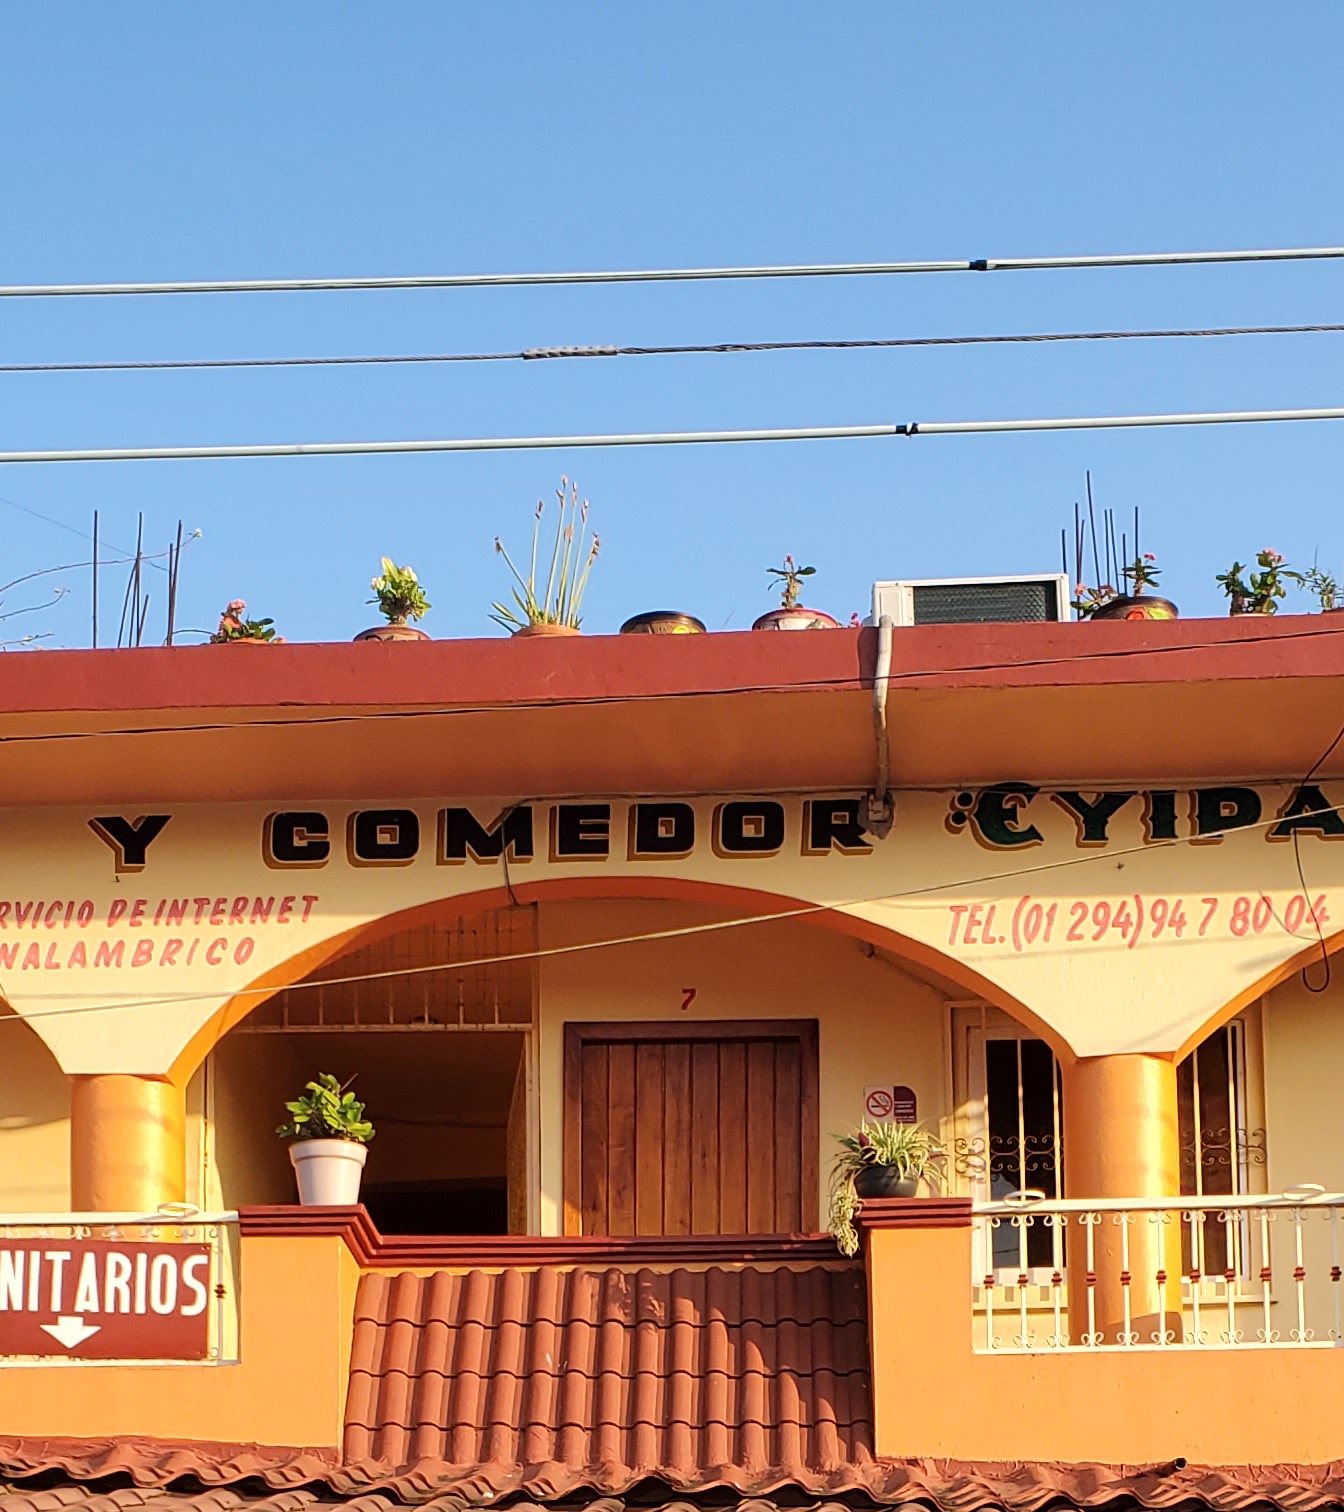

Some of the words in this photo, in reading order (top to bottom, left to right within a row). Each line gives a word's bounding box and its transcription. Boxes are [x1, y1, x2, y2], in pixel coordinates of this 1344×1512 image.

[88, 815, 174, 875] Y
[263, 800, 873, 870] COMEDOR
[681, 988, 696, 1010] 7
